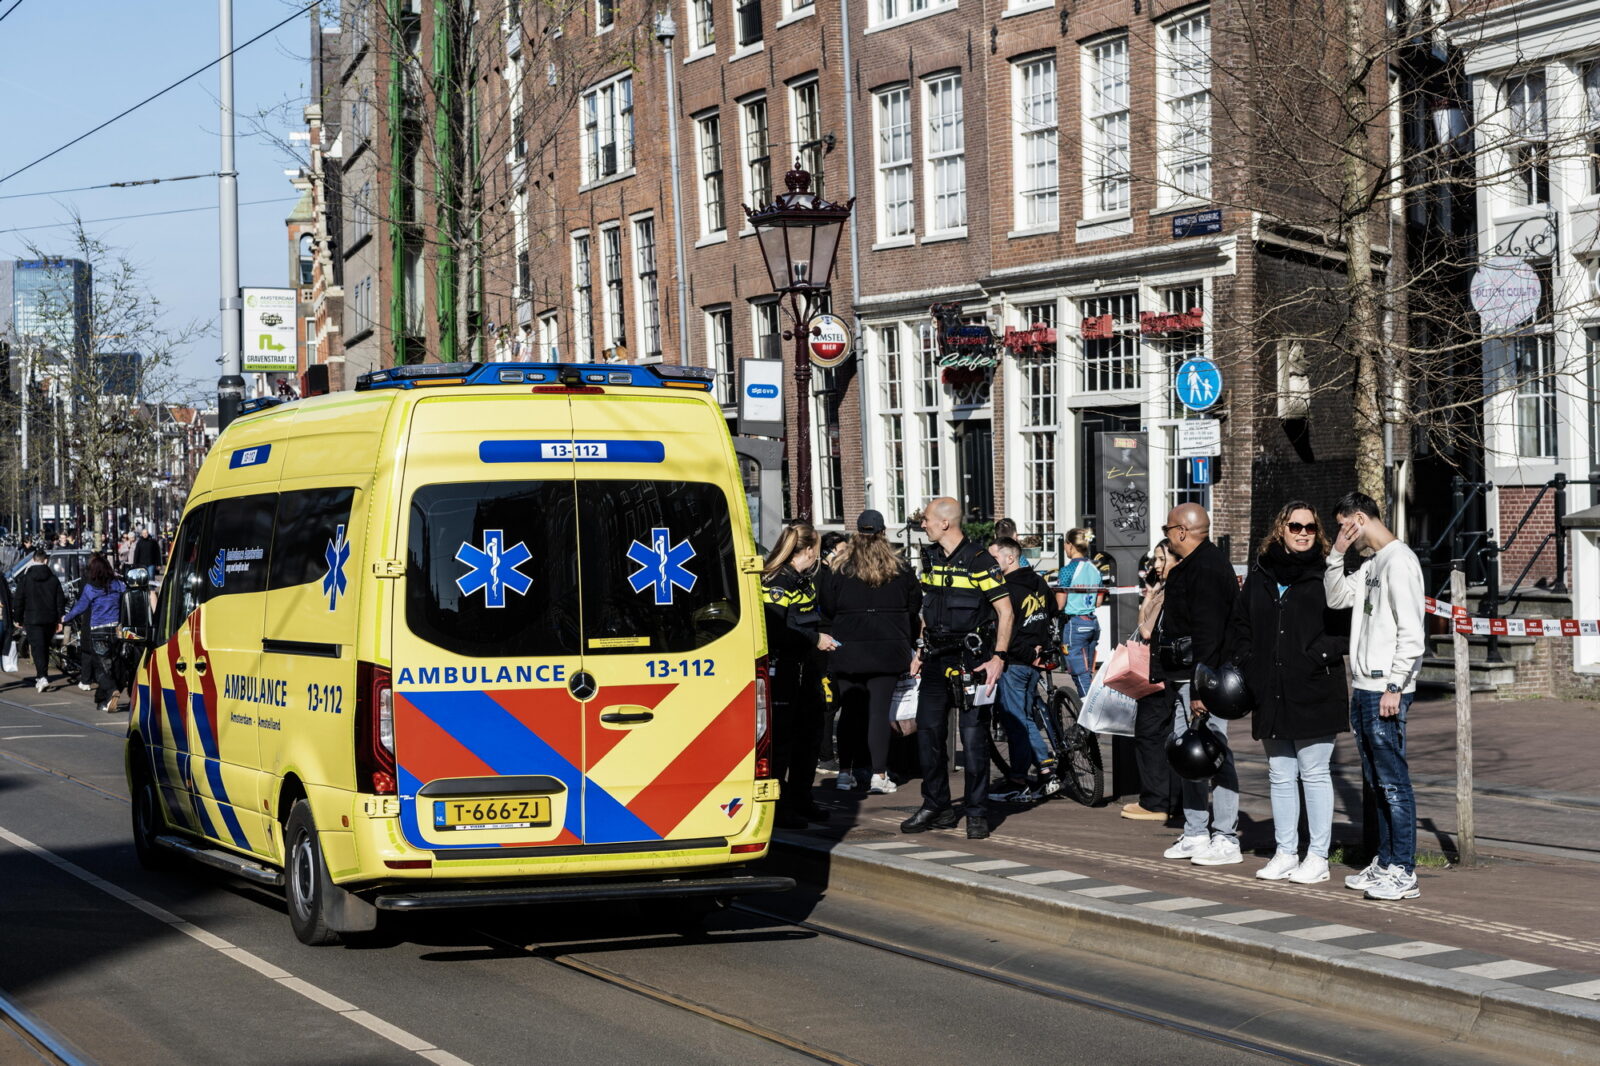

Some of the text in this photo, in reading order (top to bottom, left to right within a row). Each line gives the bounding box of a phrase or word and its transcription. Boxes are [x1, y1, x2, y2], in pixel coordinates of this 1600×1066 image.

[813, 333, 845, 341] AMSTEL
[247, 355, 295, 363] GRAVENSTRAAT 12
[550, 445, 600, 457] 13-112
[397, 658, 715, 685] AMBULANCE 13-112
[224, 673, 342, 714] AMBULANCE 13-112
[230, 711, 253, 726] Amsterdam
[257, 715, 281, 731] Amstelland
[453, 801, 539, 821] T-666-ZJ
